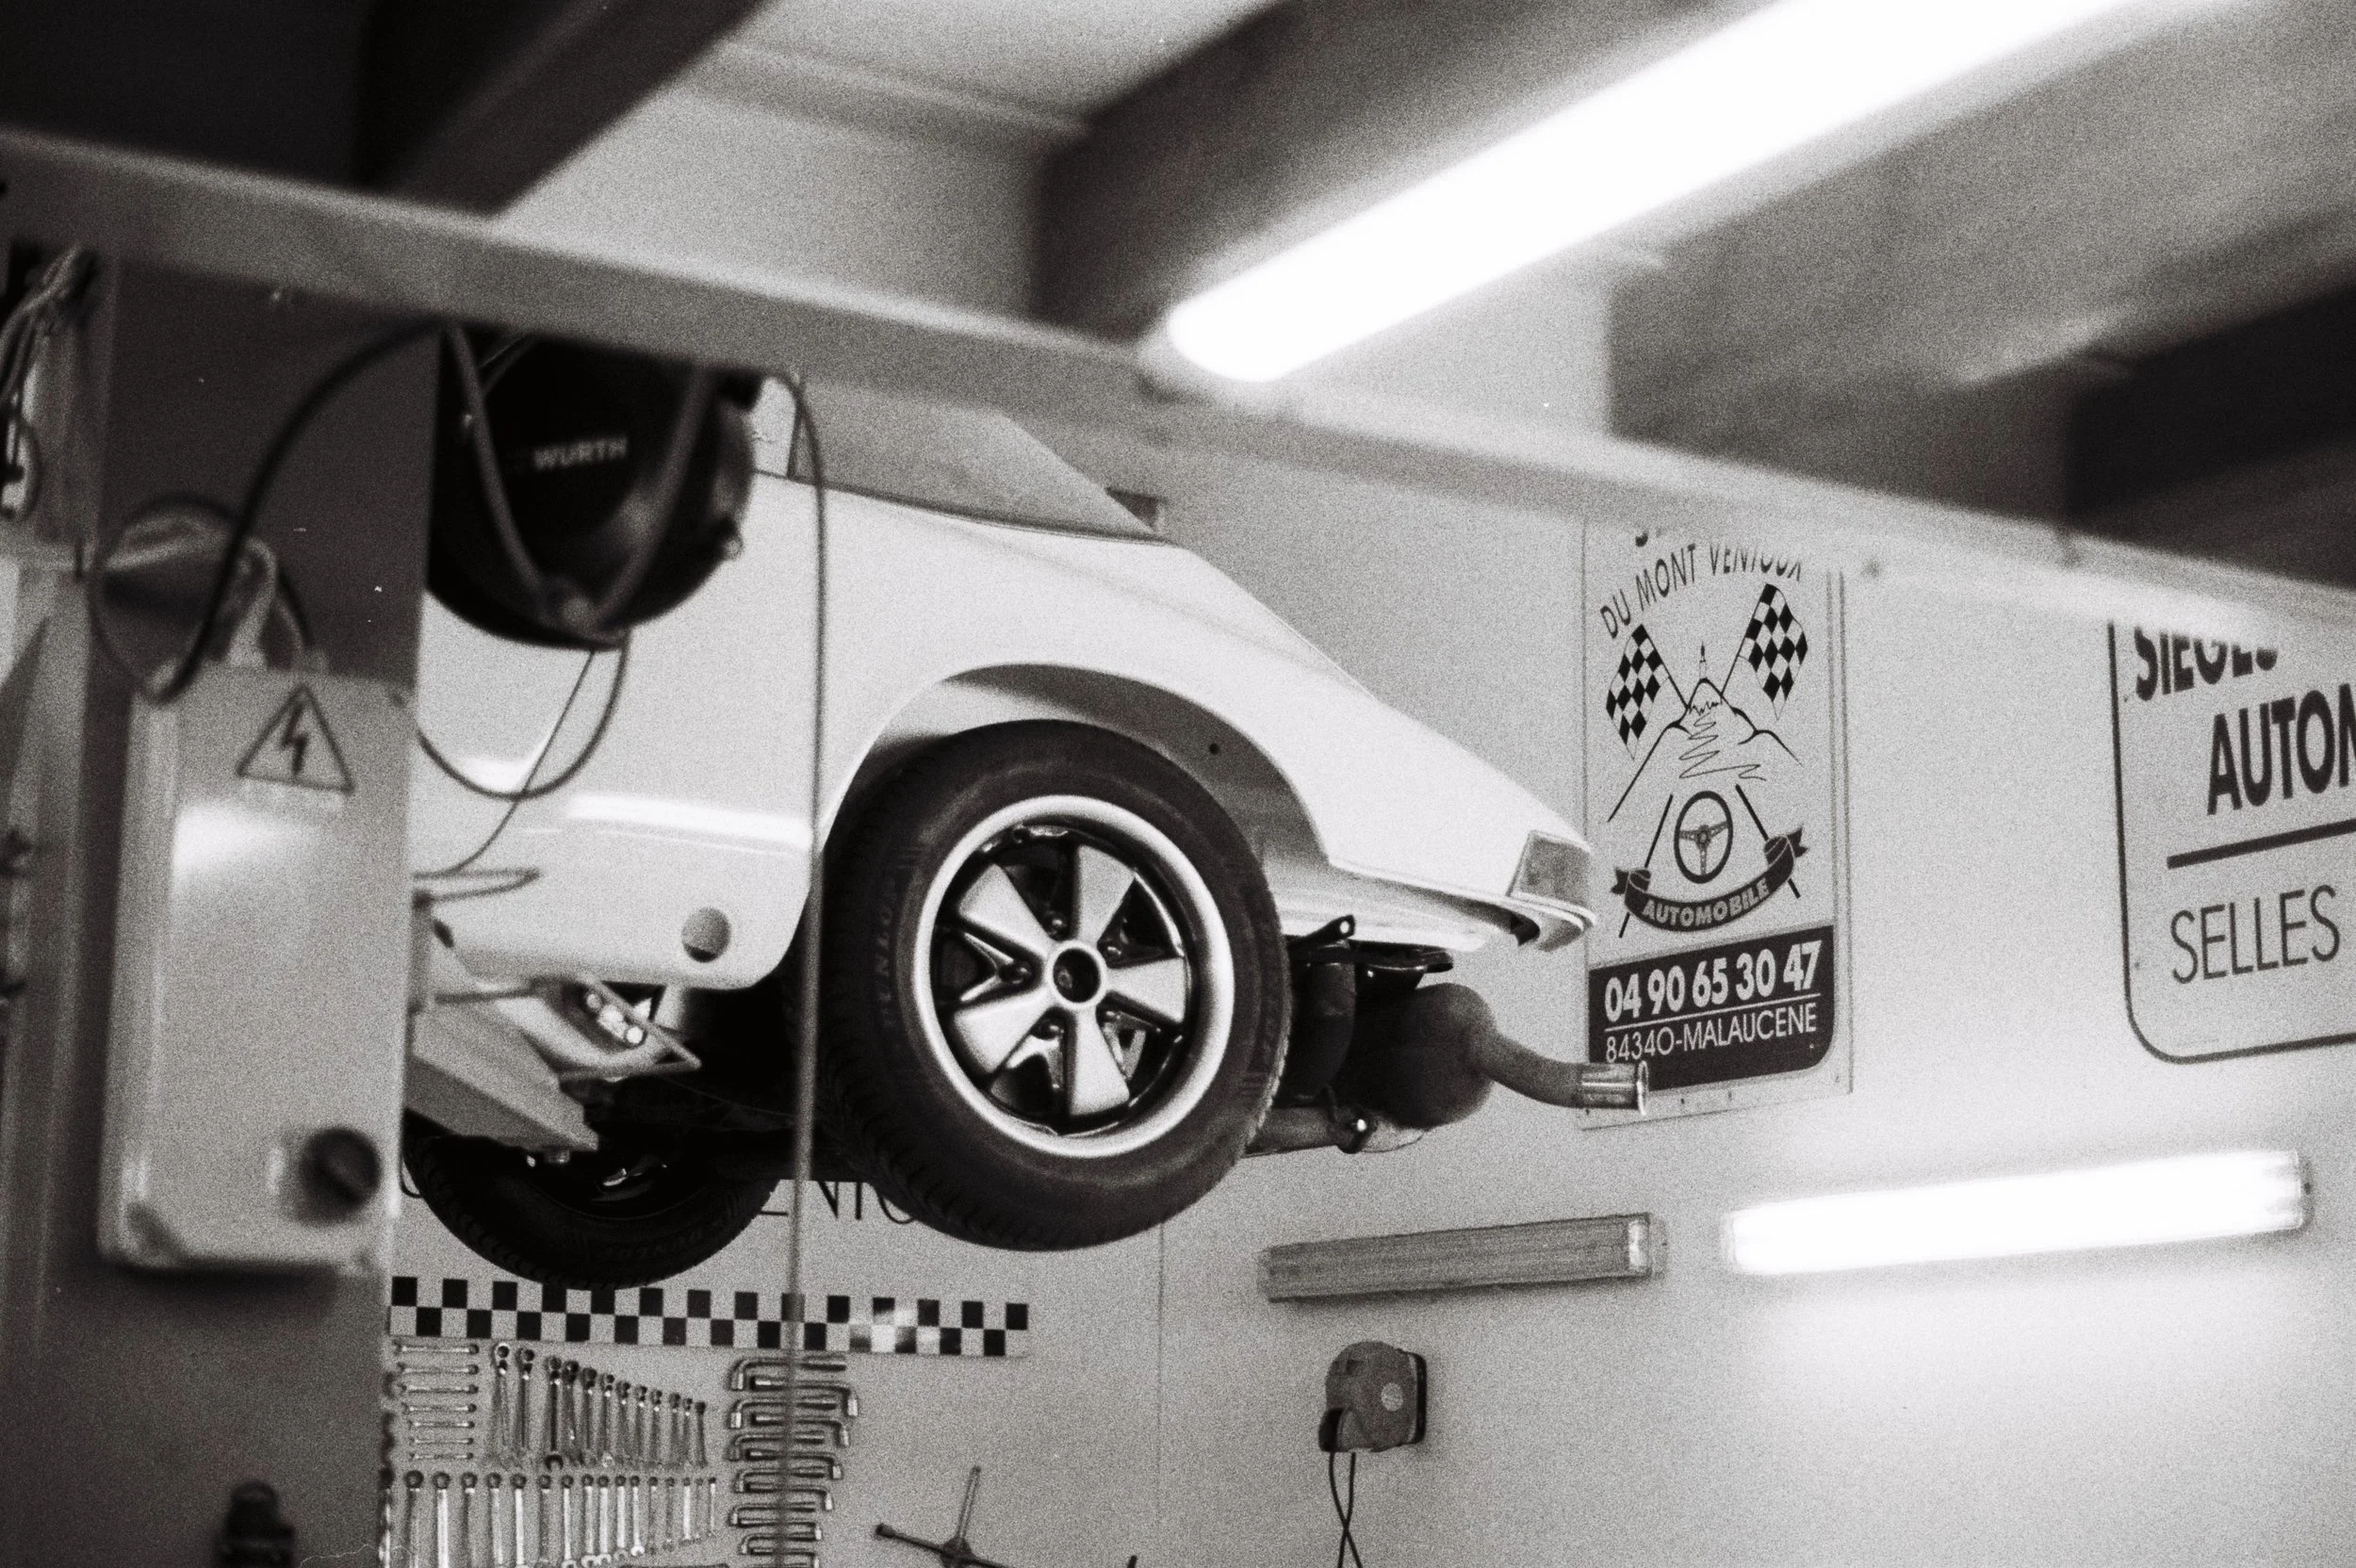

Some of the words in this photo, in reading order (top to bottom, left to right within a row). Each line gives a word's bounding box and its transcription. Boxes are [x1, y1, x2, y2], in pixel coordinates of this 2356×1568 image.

[1600, 588, 1631, 639] DU
[1635, 543, 1696, 612] MONT
[2134, 624, 2279, 701] SIEG
[1643, 877, 1770, 926] AUTOMOBILE
[2170, 884, 2341, 985] SELLES
[1604, 972, 1643, 1022] 04
[1648, 965, 1686, 1015] 90
[1693, 957, 1728, 1007] 65
[1735, 948, 1776, 1002] 30
[1783, 939, 1823, 991] 47
